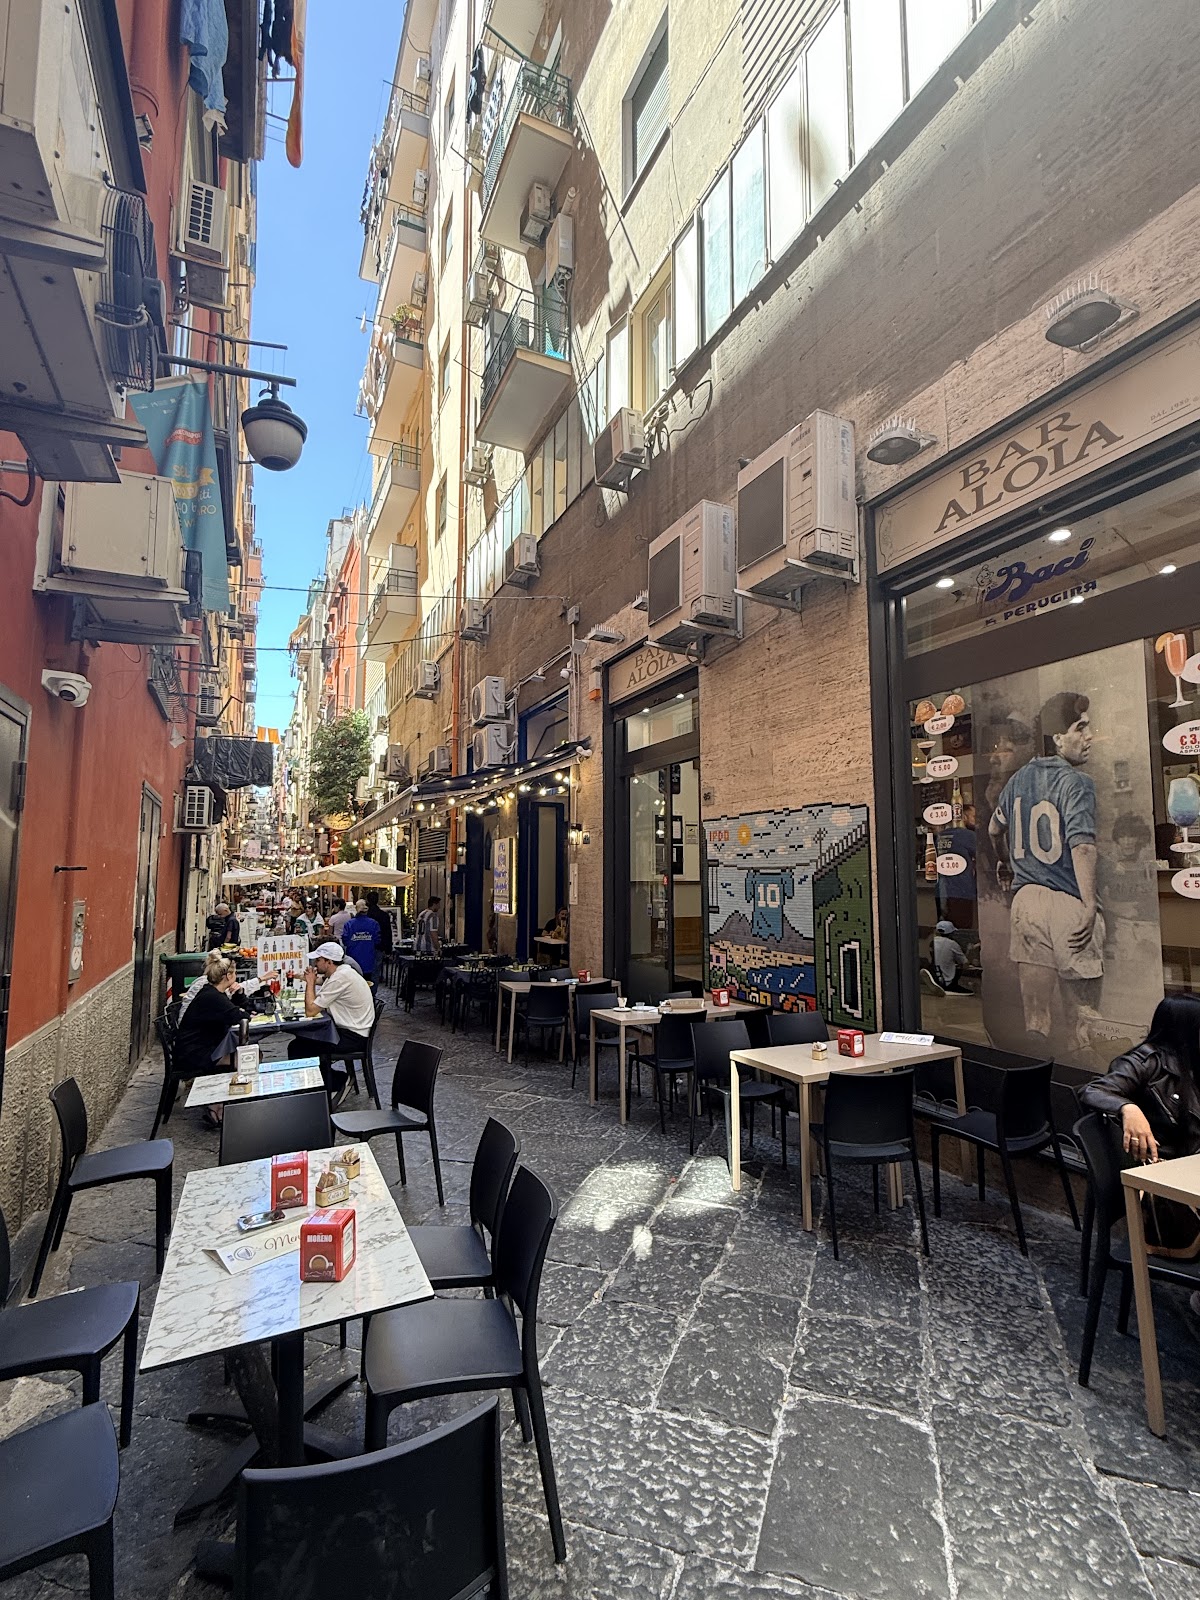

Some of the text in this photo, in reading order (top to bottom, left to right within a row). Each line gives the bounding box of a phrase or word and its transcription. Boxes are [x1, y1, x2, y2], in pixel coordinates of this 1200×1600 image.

[960, 412, 1081, 491] BAR
[934, 420, 1124, 534] ALOIA
[985, 537, 1094, 602] Baci
[1003, 580, 1097, 621] PERUGINA
[627, 652, 678, 688] ALOIA
[1013, 796, 1062, 865] 10
[758, 884, 780, 908] 10
[262, 953, 278, 962] MINI
[278, 1168, 301, 1178] MORENO
[307, 1234, 333, 1243] MORENO
